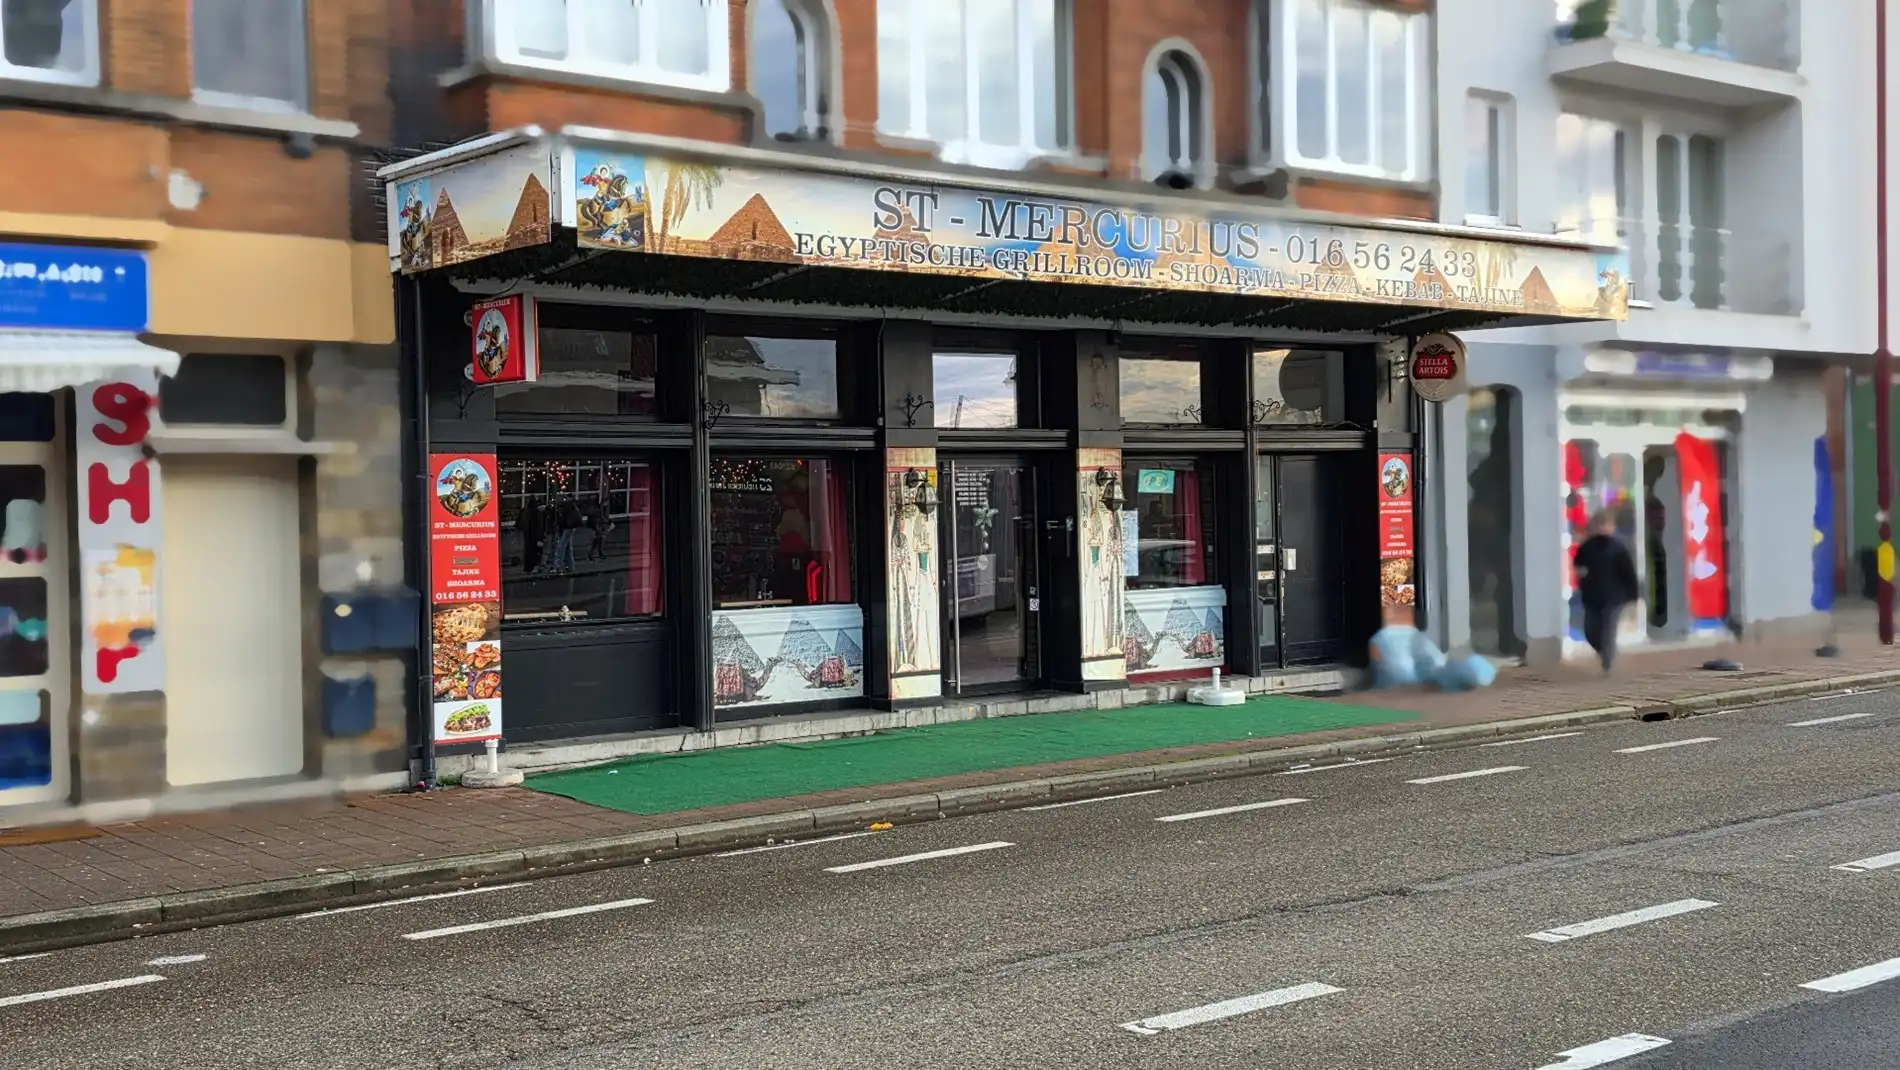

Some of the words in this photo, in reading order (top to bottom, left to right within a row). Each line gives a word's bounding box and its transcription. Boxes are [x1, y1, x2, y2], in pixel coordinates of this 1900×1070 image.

[873, 186, 939, 233] ST
[975, 196, 1260, 260] MERCURIUS
[1286, 234, 1344, 269] 016
[1353, 241, 1391, 271] 56
[1400, 245, 1437, 275] 24
[1443, 250, 1477, 278] 33
[794, 231, 985, 269] EGYPTISCHE
[992, 247, 1154, 281] GRILLROOM
[1169, 261, 1285, 290] SHOARMA
[1299, 272, 1361, 295] PIZZA
[1375, 278, 1444, 301] KEBAB
[1456, 283, 1524, 307] TAJINE
[1419, 358, 1449, 366] STELLA
[1419, 366, 1449, 375] ARTOIS
[449, 521, 495, 529] MERCURIUS
[454, 544, 477, 552] PIZZA
[447, 580, 485, 588] SHOARMA
[435, 591, 455, 600] 016
[456, 591, 469, 599] 56
[470, 590, 483, 599] 24
[485, 590, 497, 598] 33
